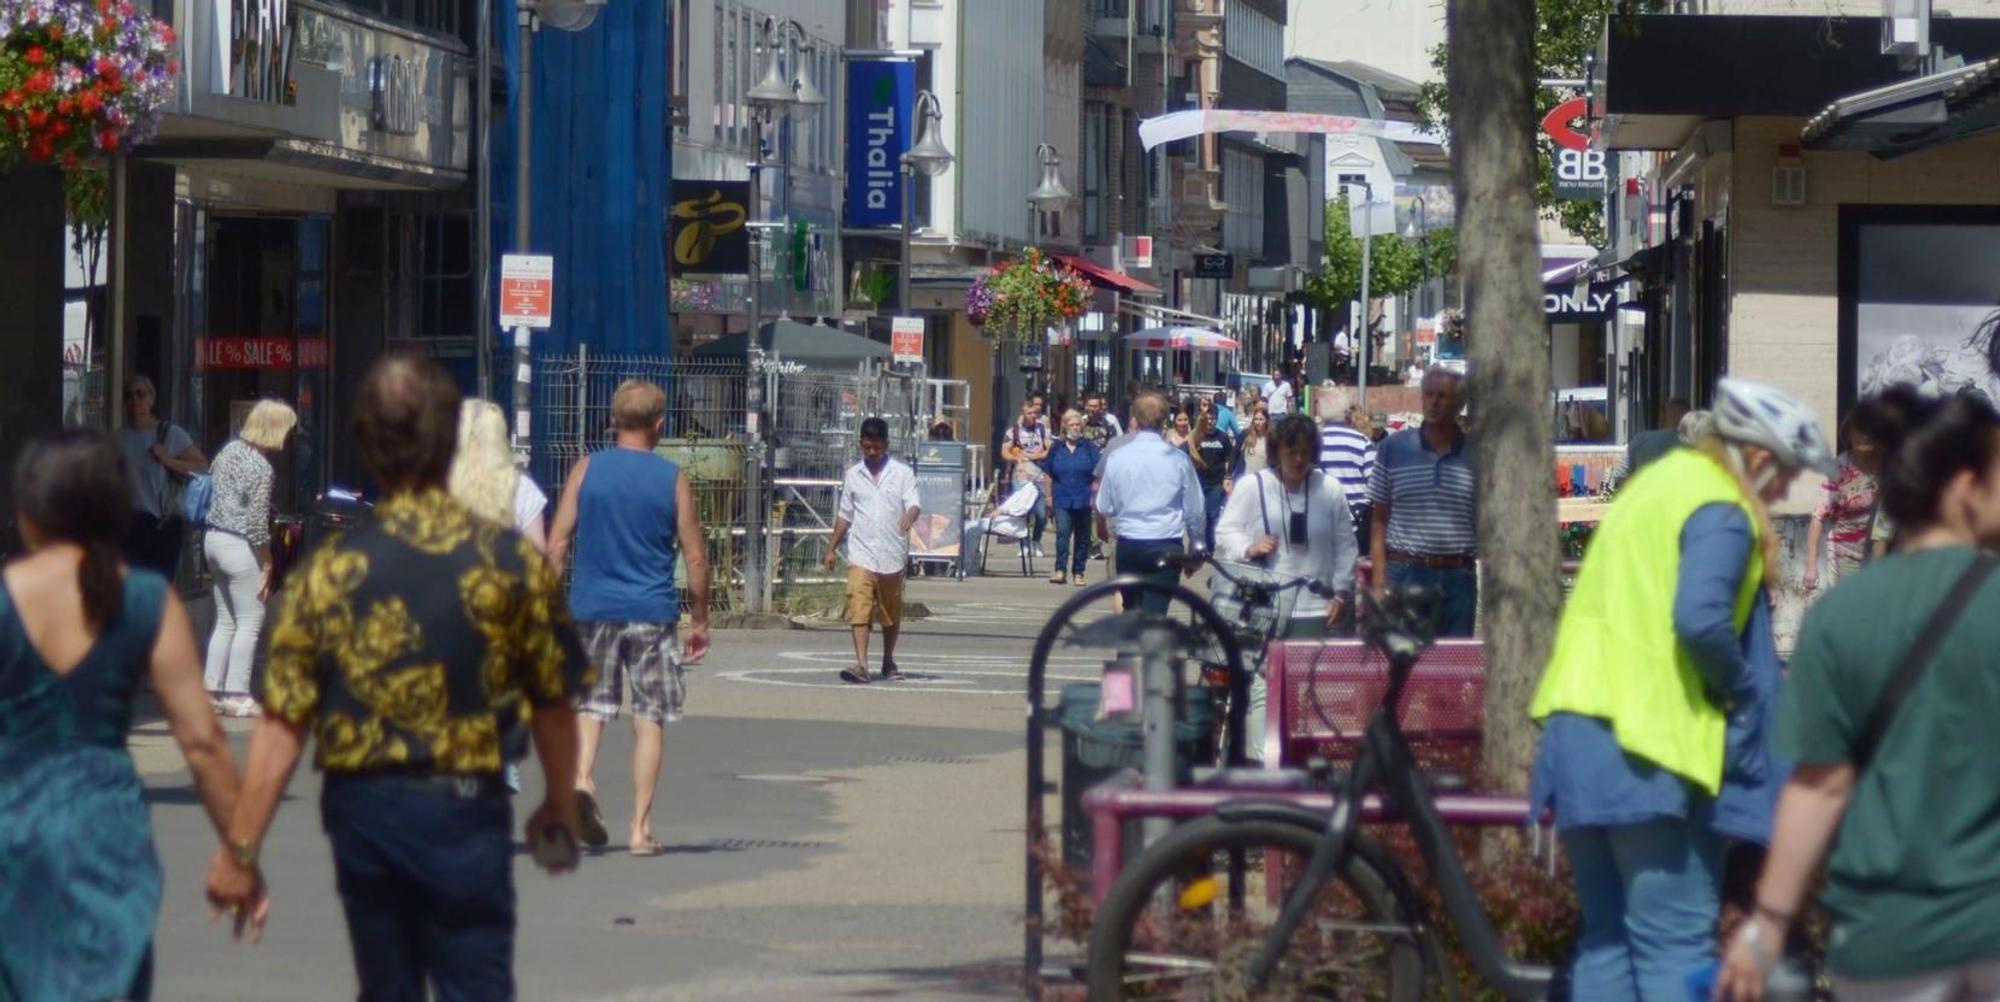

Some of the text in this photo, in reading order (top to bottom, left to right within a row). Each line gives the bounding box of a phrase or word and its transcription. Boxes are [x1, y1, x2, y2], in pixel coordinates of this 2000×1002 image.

[868, 107, 894, 208] Thalia
[1543, 294, 1612, 313] ONLY
[243, 341, 273, 365] SALE
